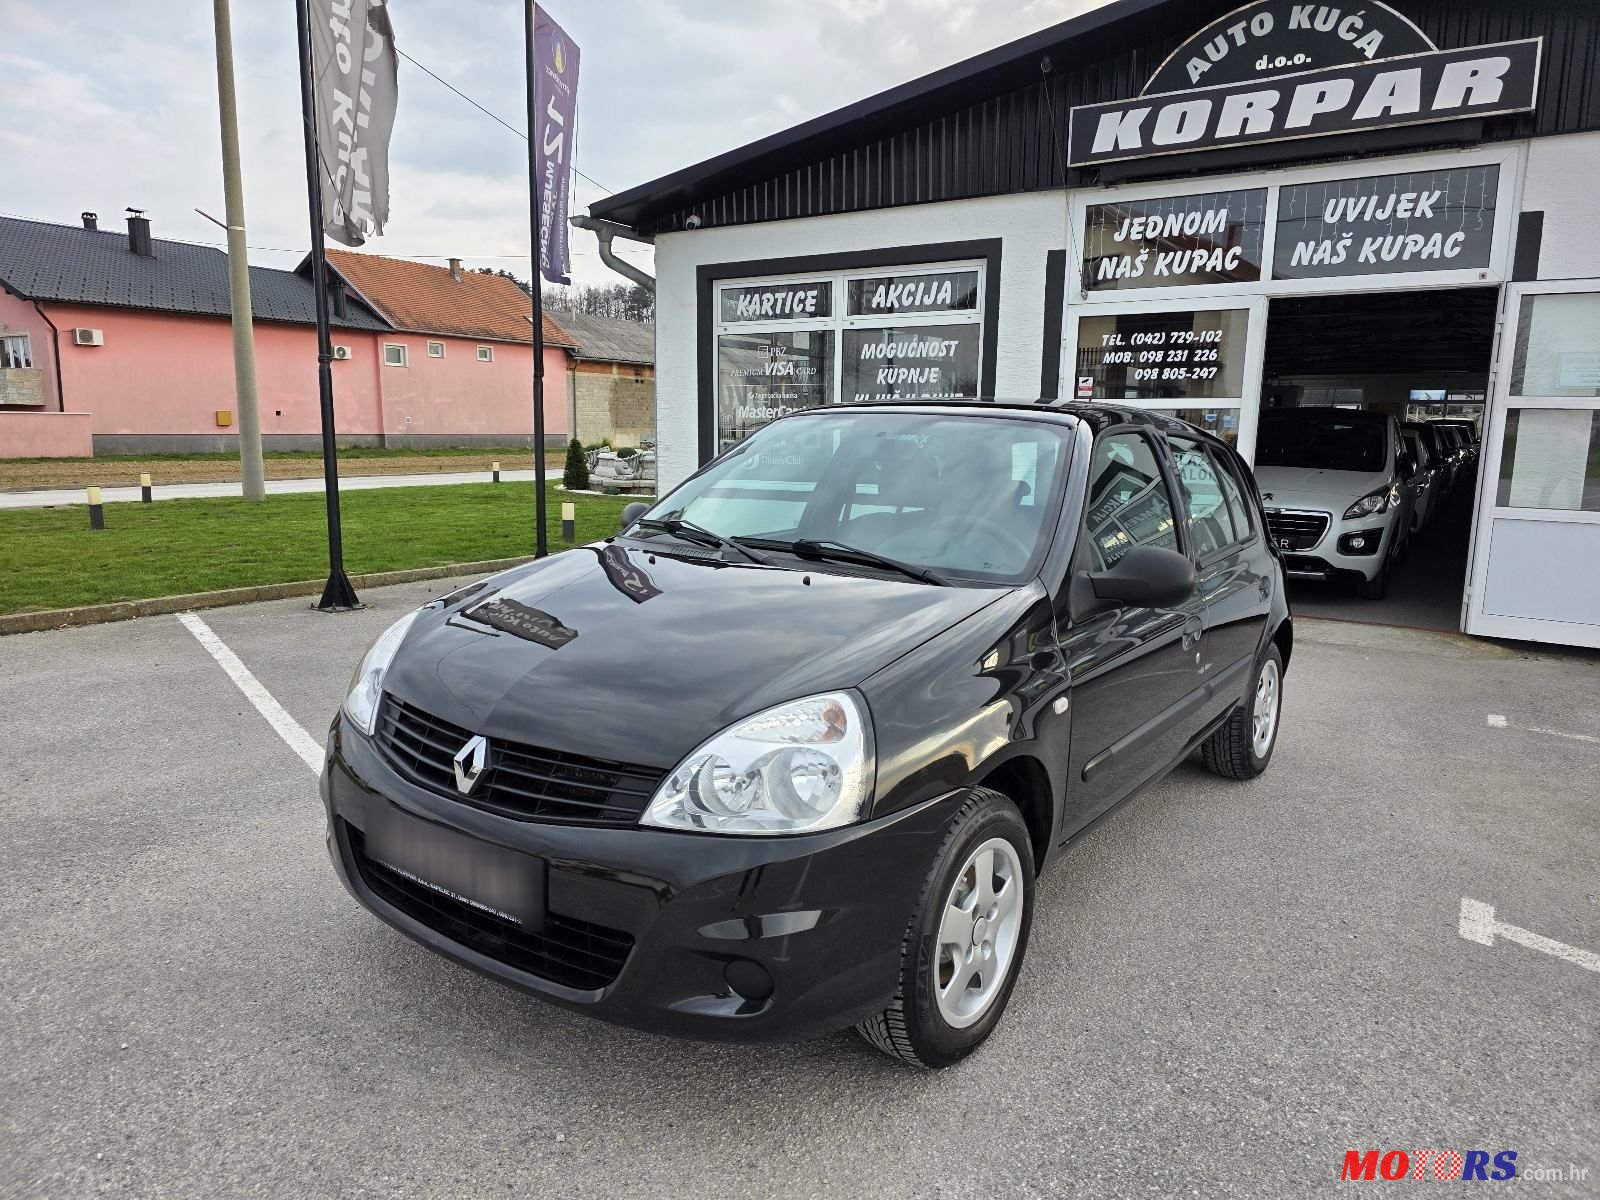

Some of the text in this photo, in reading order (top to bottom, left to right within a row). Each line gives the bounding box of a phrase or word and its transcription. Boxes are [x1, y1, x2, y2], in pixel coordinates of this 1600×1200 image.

[1185, 4, 1385, 85] AUTO KUĆA
[1255, 53, 1312, 71] d.o.o.
[1091, 56, 1511, 153] KORPAR
[1324, 190, 1441, 224] UVIJEK
[1113, 208, 1228, 242] JEDNOM
[1290, 231, 1466, 267] NAŠ KUPAC
[1097, 246, 1242, 281] NAŠ KUPAC
[736, 289, 818, 318] KARTICE
[871, 280, 953, 309] AKCIJA
[861, 337, 960, 360] MOGUĆNOST
[1102, 330, 1223, 347] TEL. (042) 729-102
[764, 360, 794, 376] VISA
[796, 366, 817, 376] CARD
[1103, 348, 1218, 364] MOB. 098 231 226
[876, 367, 940, 385] KUPNJE
[1134, 366, 1218, 381] 098 805-247
[761, 454, 804, 465] Diners Club
